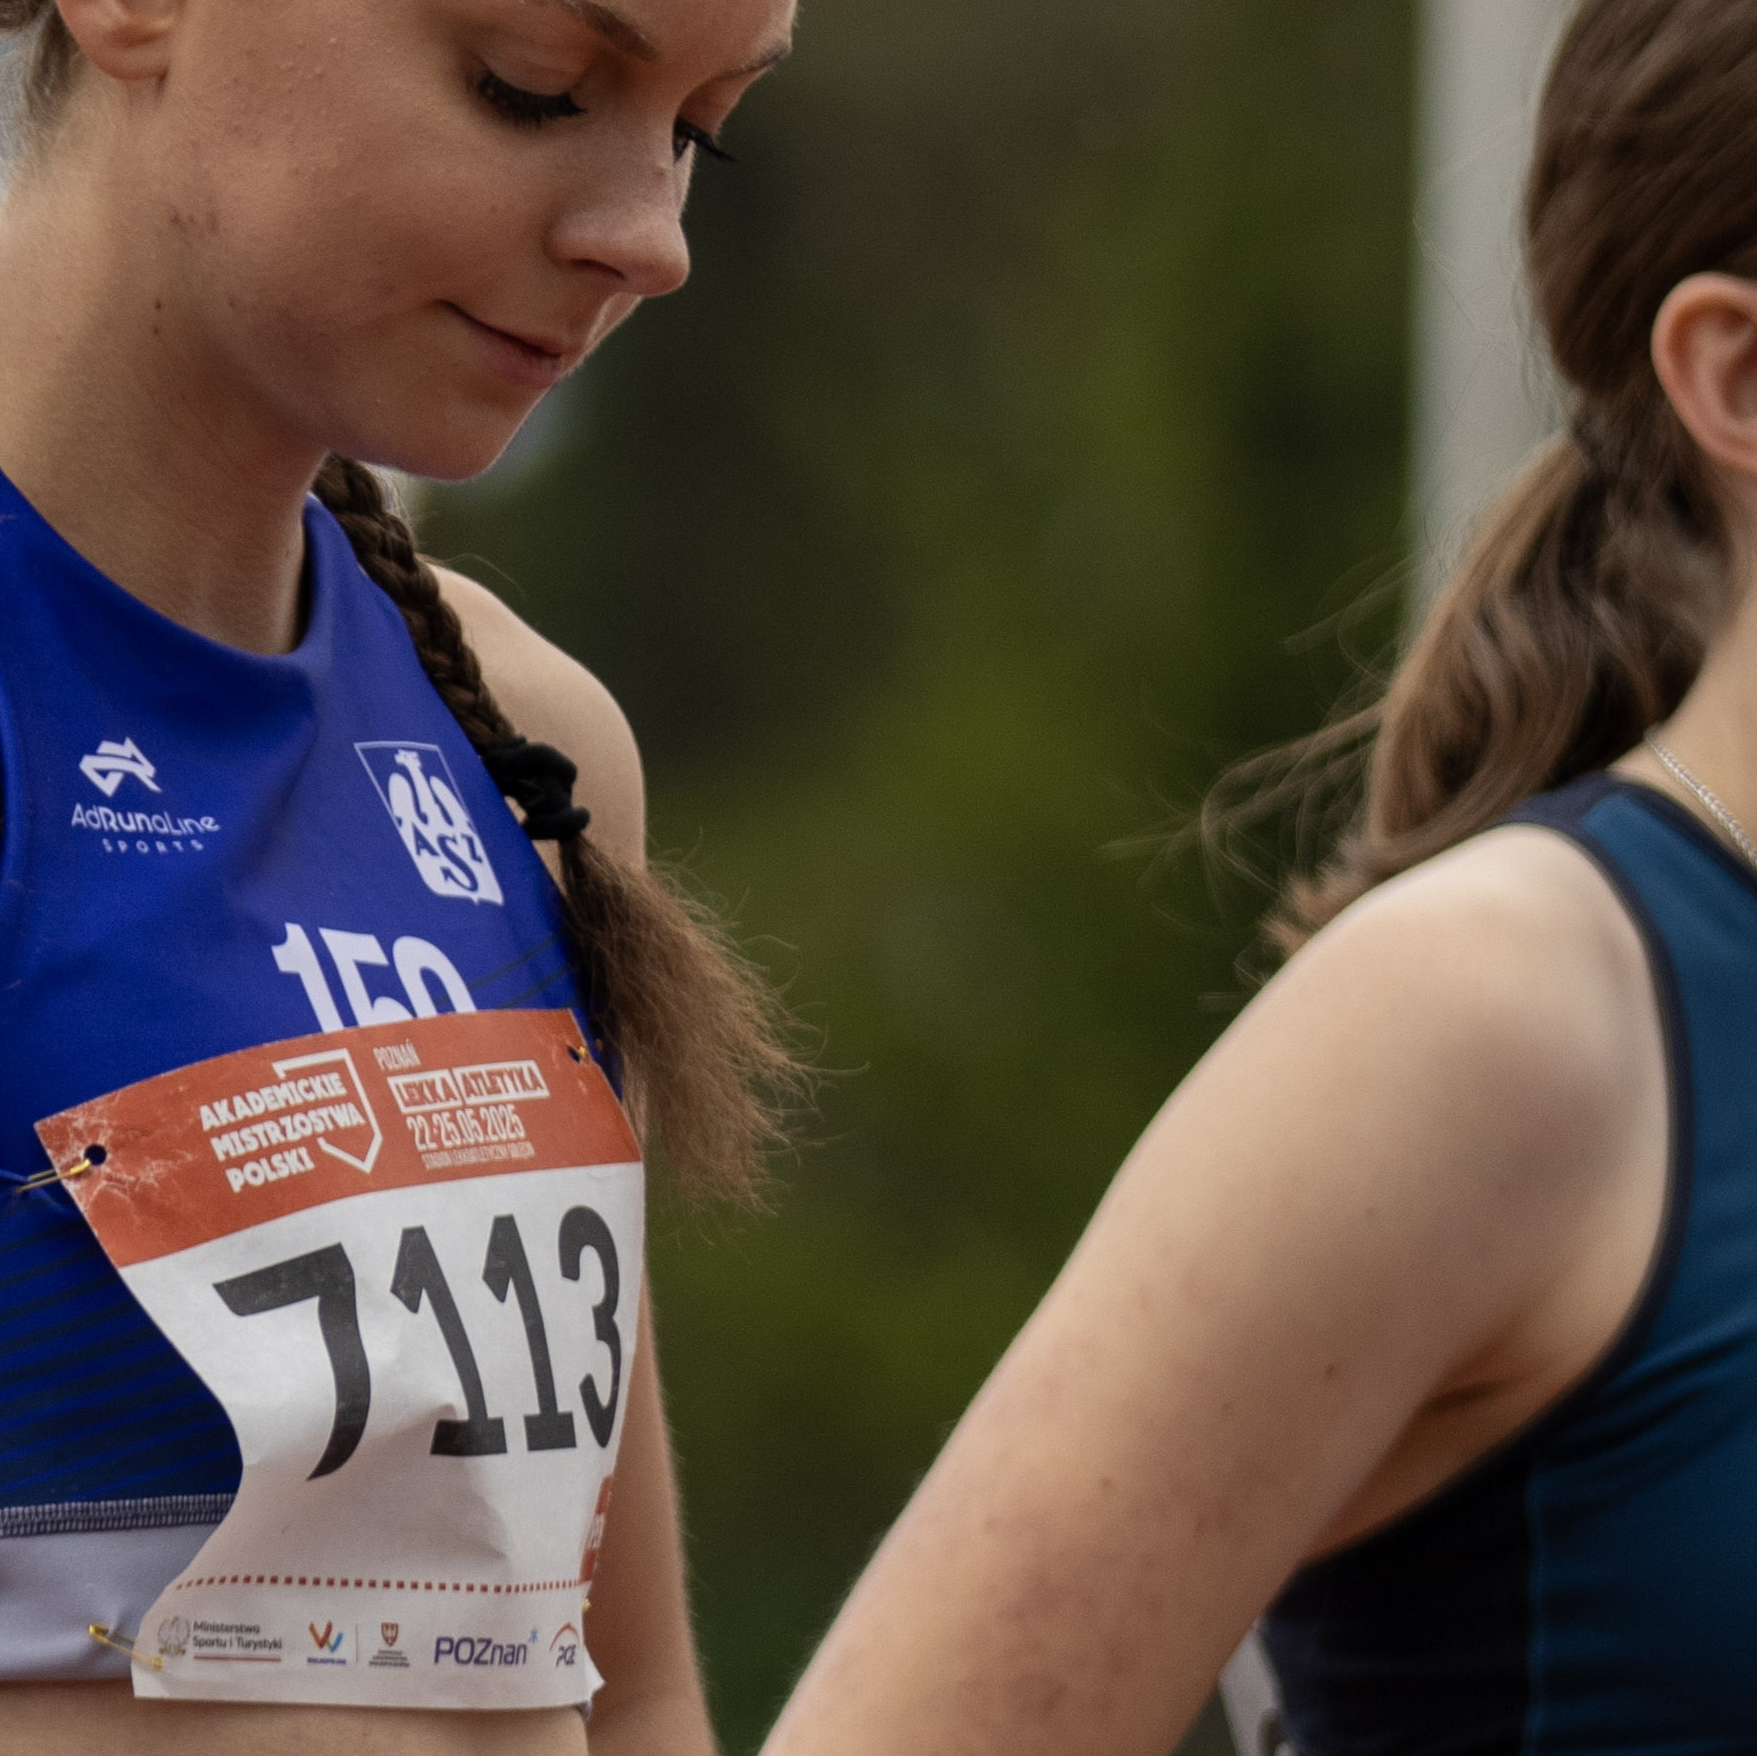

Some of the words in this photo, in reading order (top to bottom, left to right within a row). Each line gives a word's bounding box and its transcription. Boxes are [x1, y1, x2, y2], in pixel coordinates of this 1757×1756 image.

[102, 838, 205, 854] SPORTS
[373, 1038, 422, 1071] POZNAŃ
[199, 1071, 348, 1132] AKADEMICKIE
[394, 1076, 458, 1107] LEKKA
[460, 1066, 544, 1098] ATLETYKA
[210, 1102, 366, 1162] MISTRZOSTWA
[225, 1146, 316, 1194] POLSKI
[213, 1205, 622, 1481] 7113
[192, 1635, 227, 1650] Sportu
[236, 1636, 283, 1650] Turystyki
[193, 1621, 261, 1634] Ministerstwo
